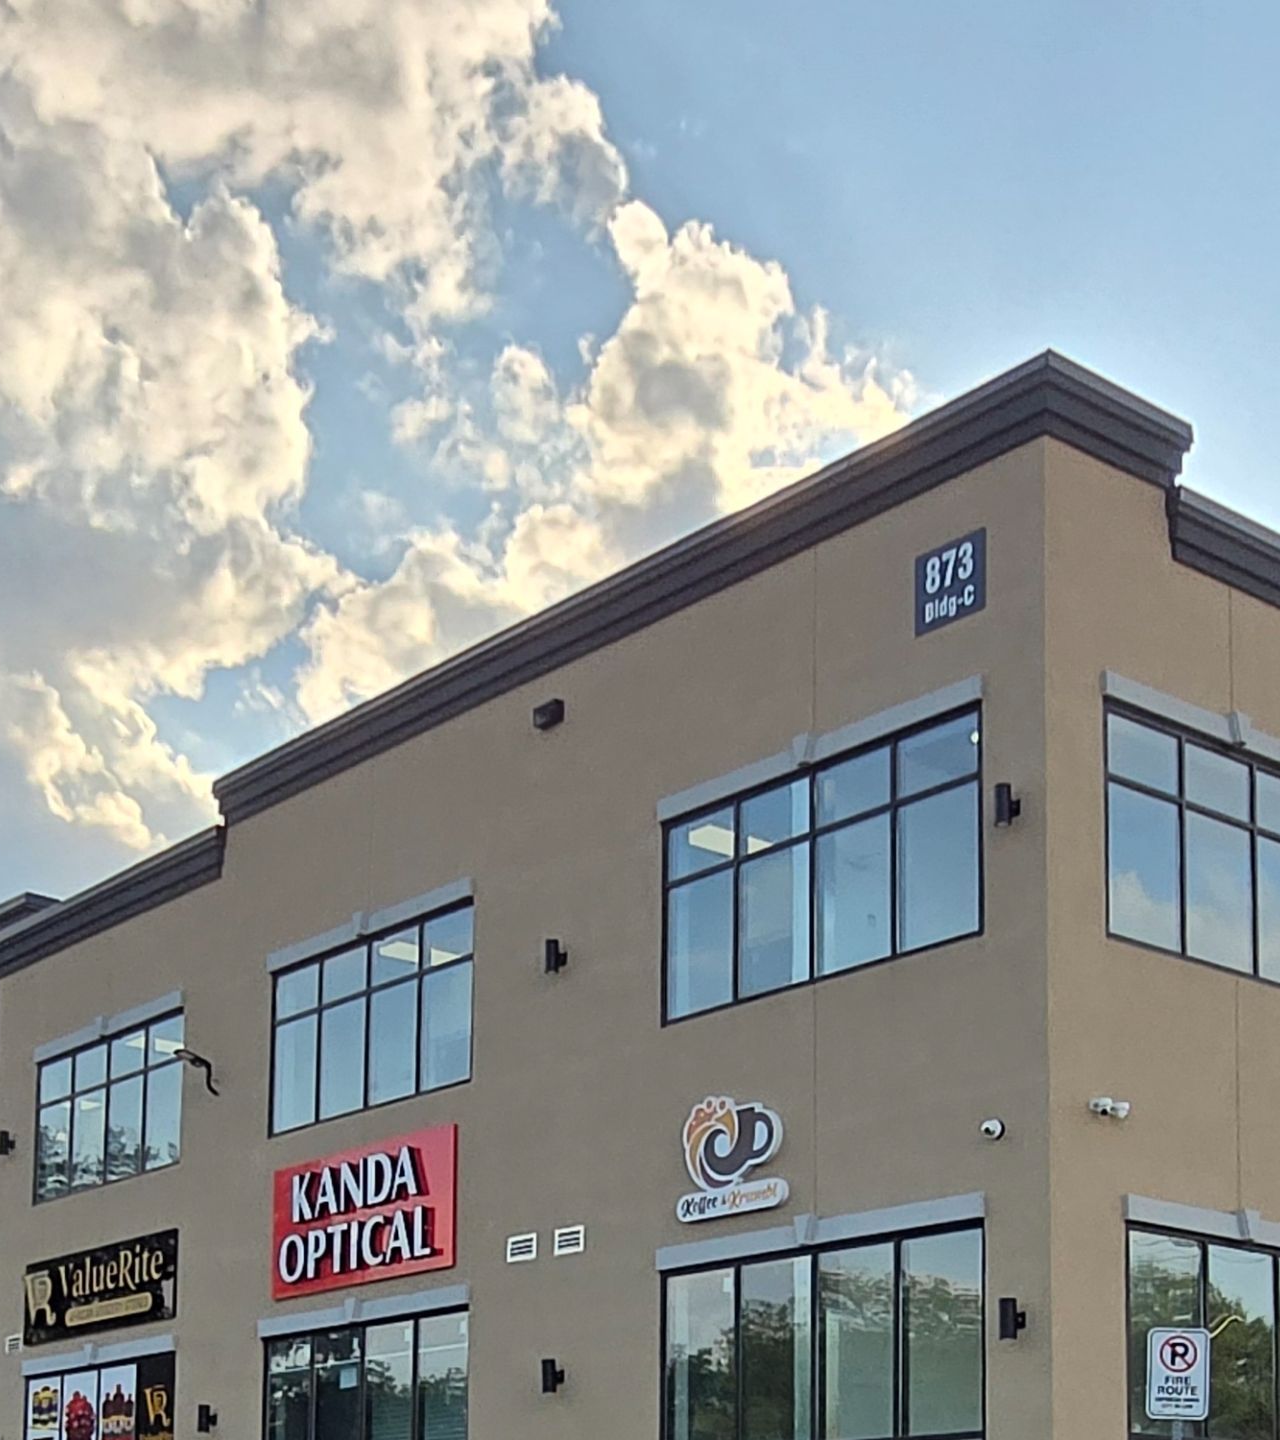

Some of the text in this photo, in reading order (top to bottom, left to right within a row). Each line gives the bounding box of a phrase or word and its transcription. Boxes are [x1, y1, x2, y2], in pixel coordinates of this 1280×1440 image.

[925, 541, 974, 594] 873
[925, 584, 975, 624] Bldg-C
[292, 1145, 418, 1224] KANDA
[58, 1244, 164, 1298] ValueRite
[279, 1205, 432, 1284] OPTICAL
[1156, 1385, 1199, 1397] ROUTE
[1164, 1375, 1192, 1386] FIRE
